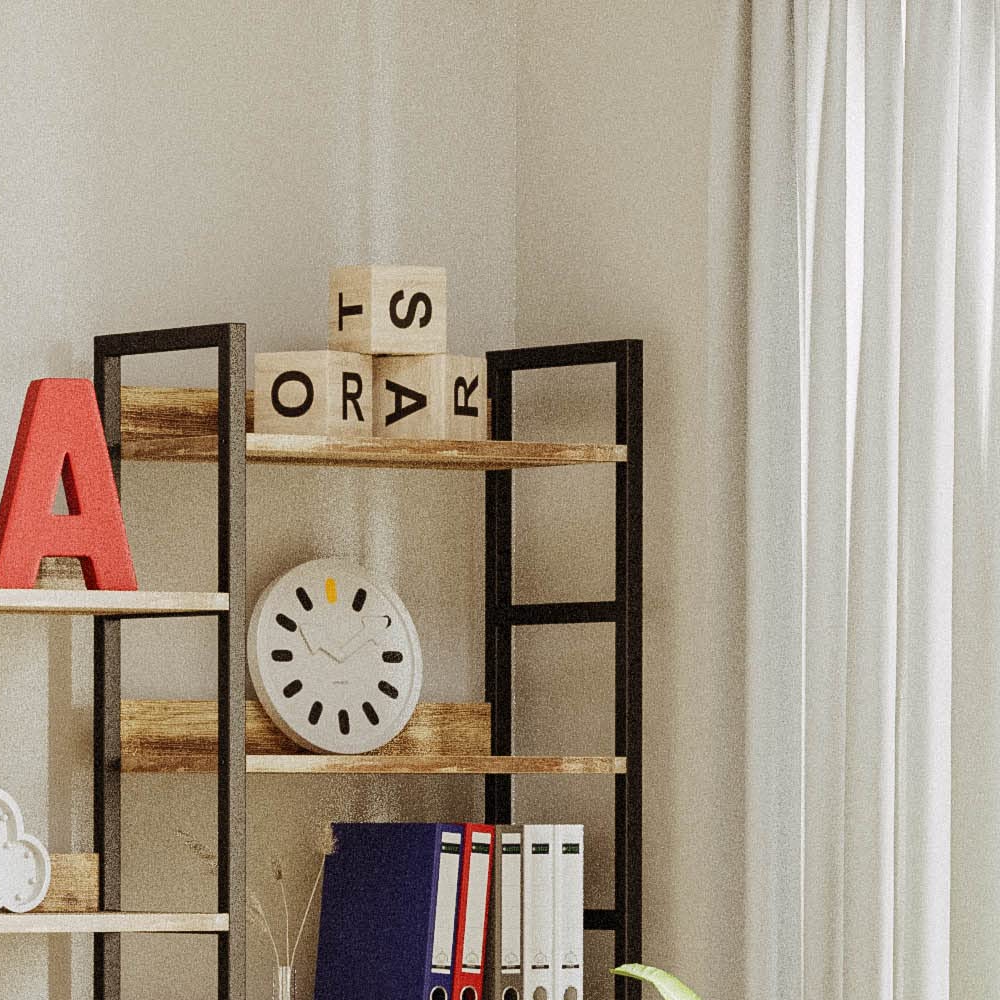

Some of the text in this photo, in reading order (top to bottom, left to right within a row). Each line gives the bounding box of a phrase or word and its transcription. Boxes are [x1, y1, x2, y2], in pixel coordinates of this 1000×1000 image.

[338, 291, 363, 332] T
[389, 289, 433, 330] S
[271, 370, 314, 418] O
[341, 371, 365, 422] R
[385, 378, 428, 428] A
[453, 374, 479, 418] R
